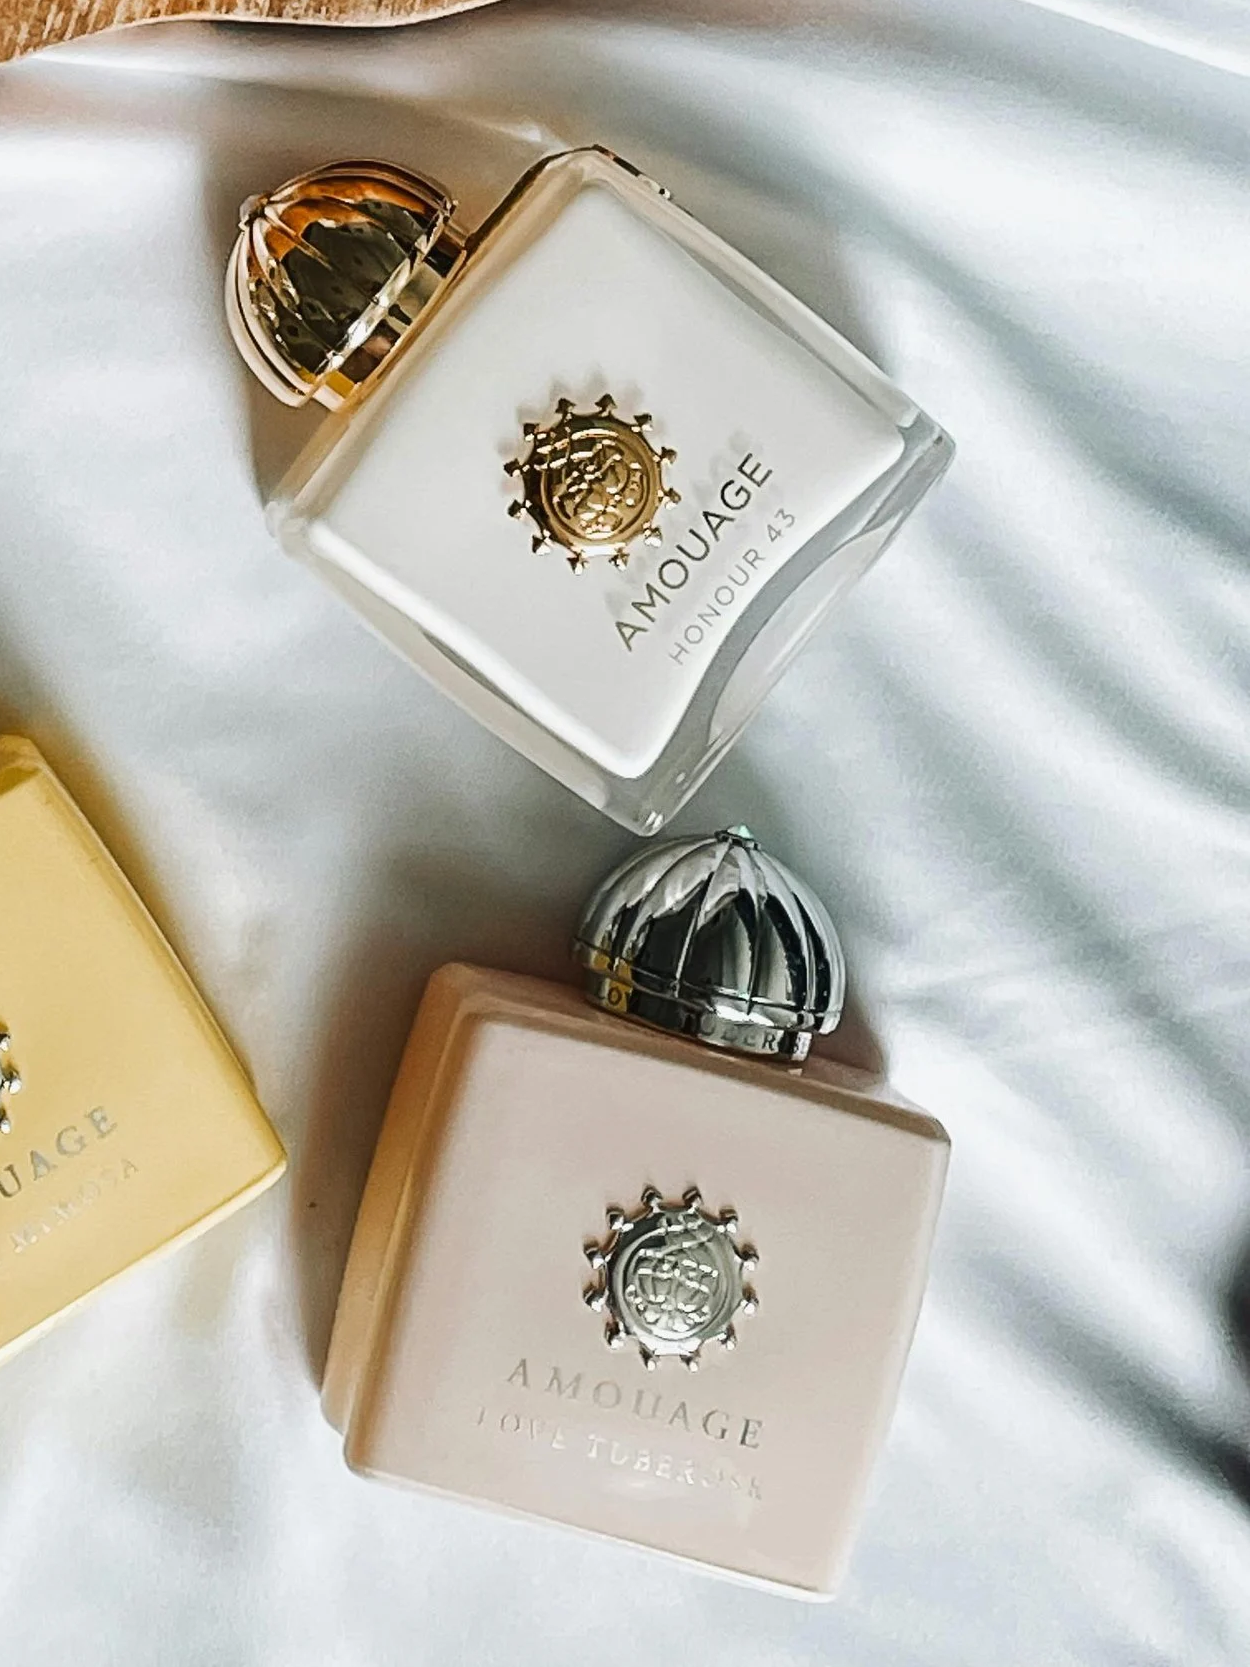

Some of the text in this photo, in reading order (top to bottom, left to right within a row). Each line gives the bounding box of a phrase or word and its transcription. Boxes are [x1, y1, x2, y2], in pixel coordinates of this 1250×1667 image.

[615, 453, 773, 651] AMOUAGE
[668, 508, 796, 665] HONOUR 43
[507, 1358, 763, 1450] AMOUAGE
